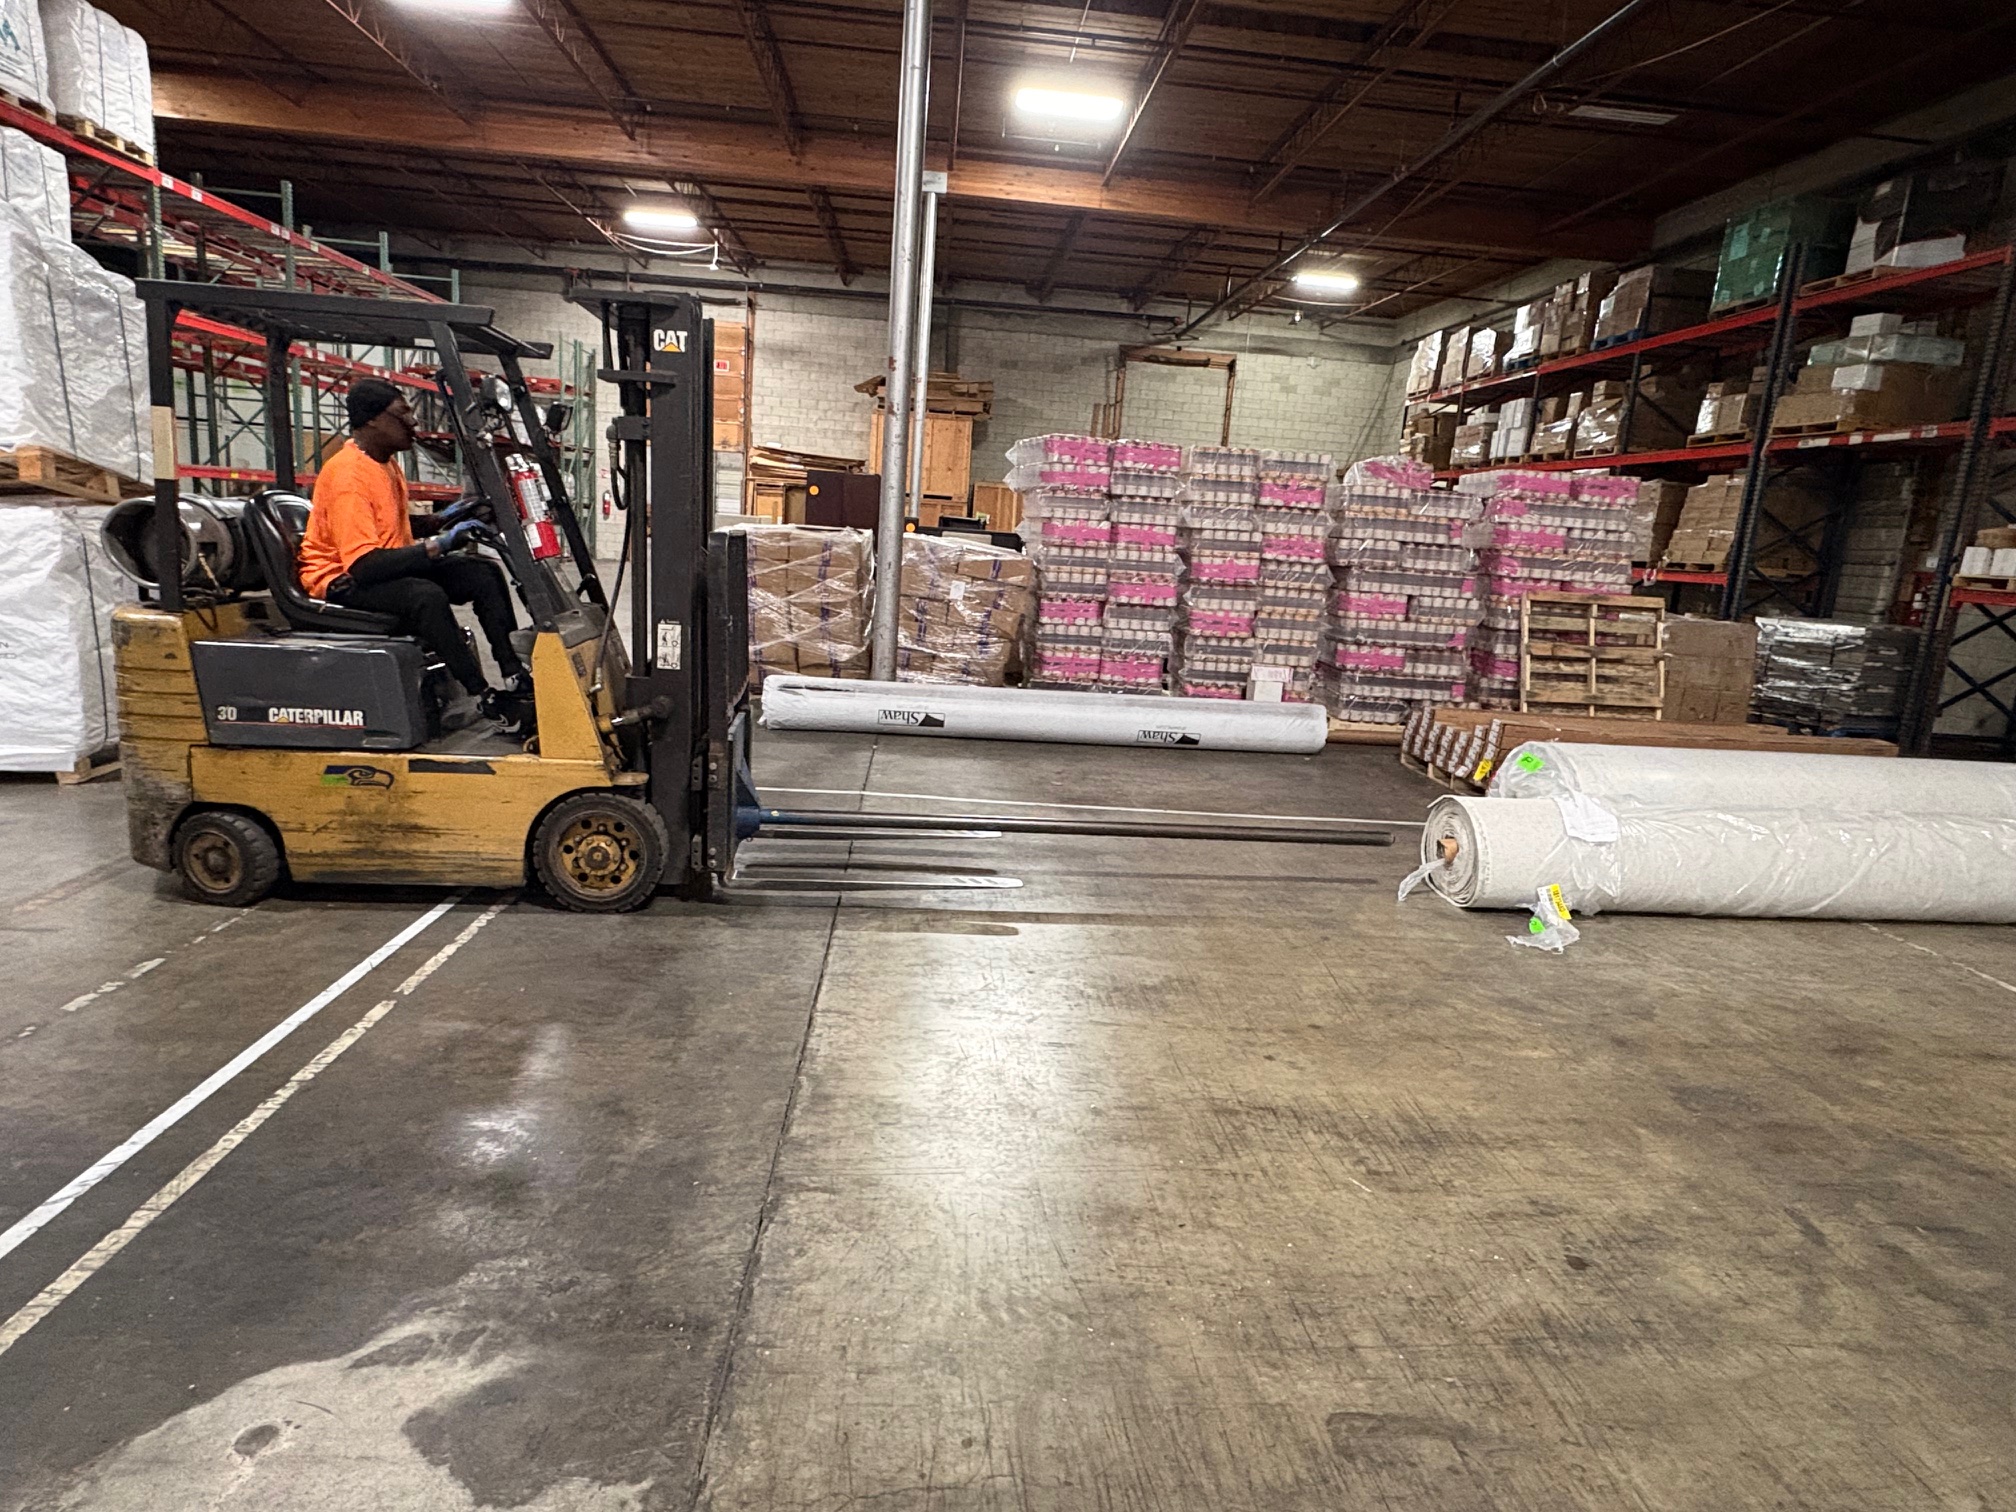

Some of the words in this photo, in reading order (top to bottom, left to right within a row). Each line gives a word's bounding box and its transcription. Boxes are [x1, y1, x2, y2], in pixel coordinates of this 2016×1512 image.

[653, 328, 688, 353] CAT
[217, 706, 238, 721] 30
[268, 707, 365, 726] CATERPILLAR
[881, 710, 920, 725] Shaw
[1140, 729, 1176, 744] Shaw
